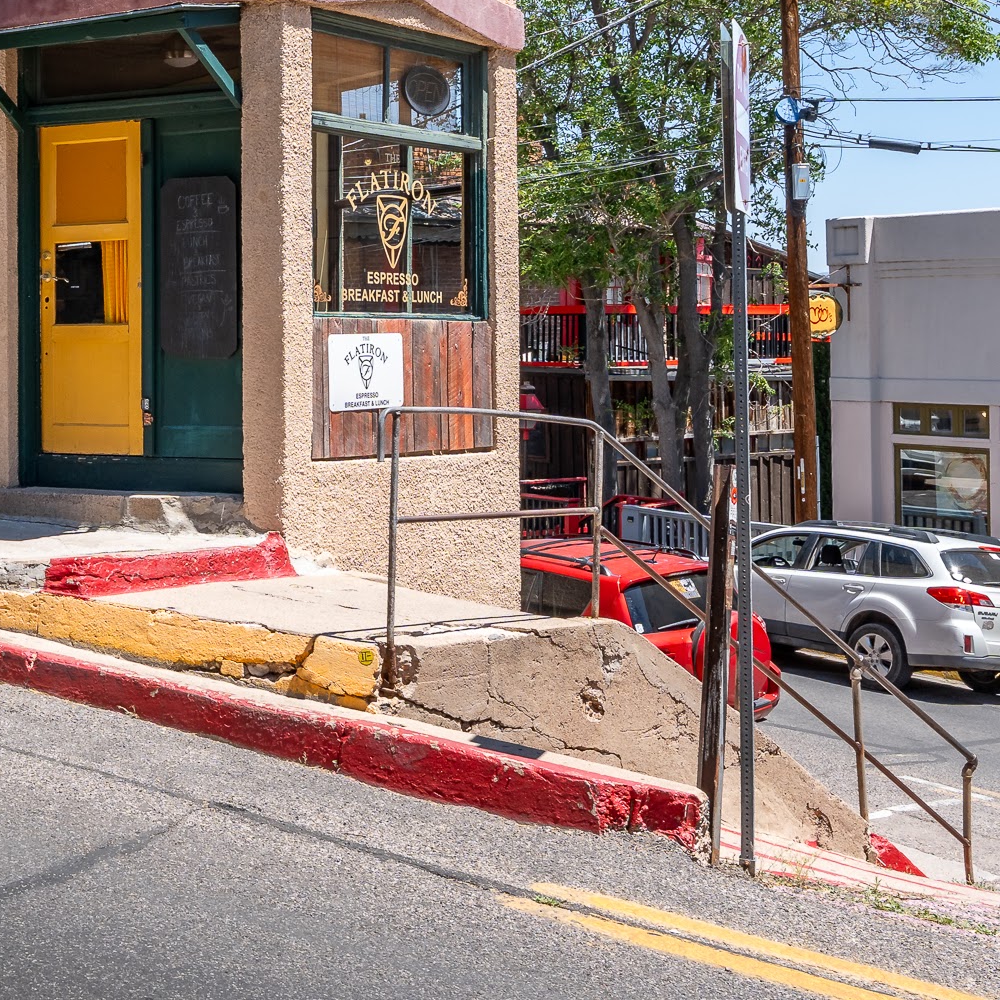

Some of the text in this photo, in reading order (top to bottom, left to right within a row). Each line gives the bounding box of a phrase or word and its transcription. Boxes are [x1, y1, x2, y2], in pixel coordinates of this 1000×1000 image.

[410, 79, 443, 104] OPEN
[385, 153, 401, 163] THE
[177, 192, 214, 209] COFFEE
[345, 169, 439, 216] FLATIRON
[367, 271, 419, 286] ESPRESSO
[342, 288, 442, 304] BREAKFAST & LUNCH
[344, 343, 388, 366] FLATIRON
[356, 391, 379, 400] ESPRESSO
[345, 400, 371, 408] BREAKFAST
